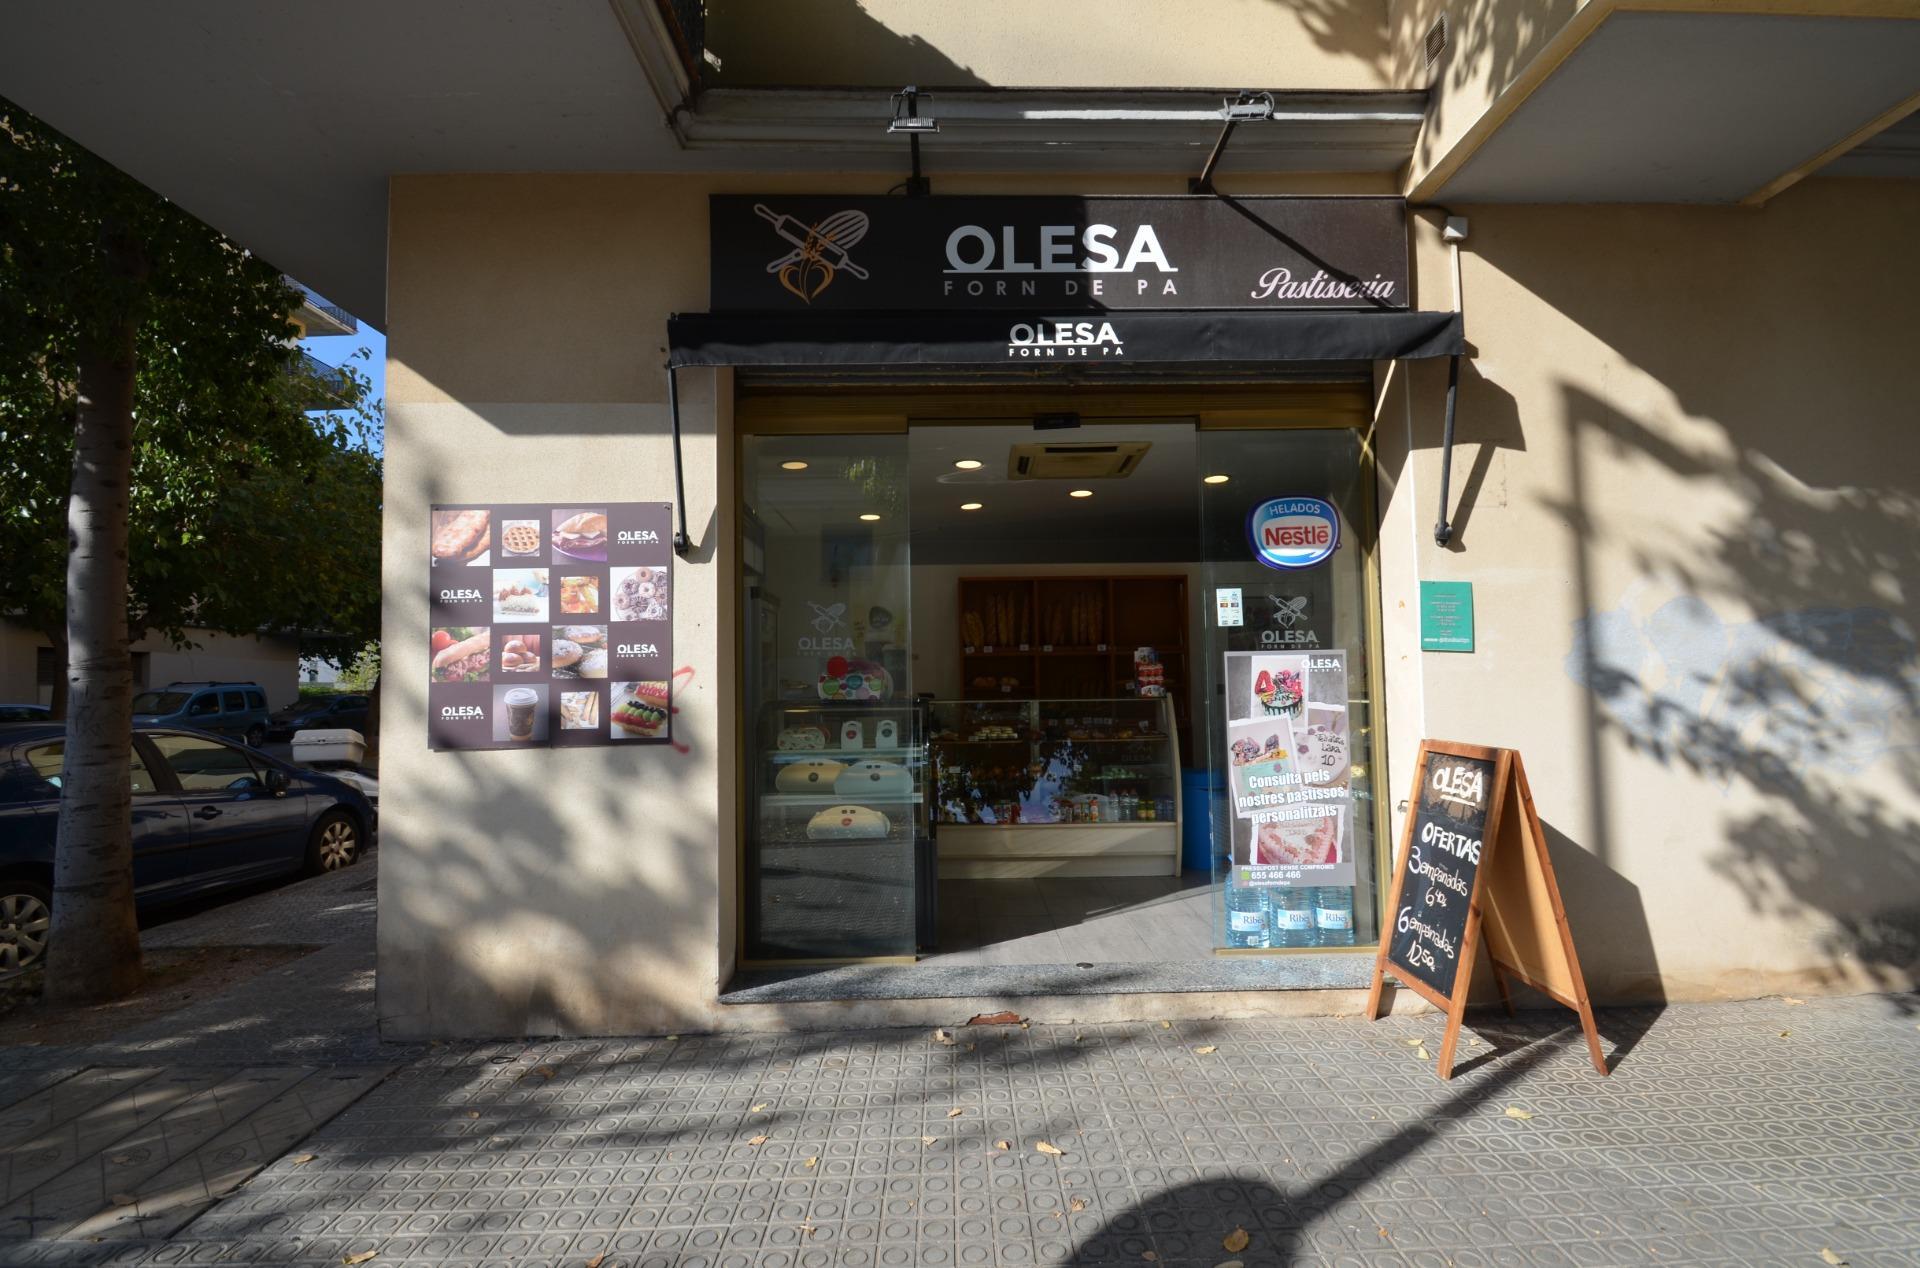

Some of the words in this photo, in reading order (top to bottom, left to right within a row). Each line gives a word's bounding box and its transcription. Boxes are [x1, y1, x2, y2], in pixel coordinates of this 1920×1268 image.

[945, 224, 1173, 273] OLESA
[944, 280, 1036, 295] FORN
[1065, 279, 1104, 295] DE
[1137, 278, 1178, 295] PA
[1250, 267, 1396, 299] Pastisseria
[1009, 322, 1122, 345] OLESA
[1009, 347, 1055, 357] FORN
[1067, 347, 1088, 356] DE
[1102, 346, 1124, 356] PA
[1269, 503, 1321, 516] HELADOS
[617, 530, 659, 540] OLESA
[440, 589, 482, 599] OLESA
[798, 637, 856, 650] OLESA
[1261, 630, 1318, 643] OLESA
[616, 644, 658, 654] OLESA
[1301, 658, 1341, 669] OLESA
[441, 706, 484, 716] OLESA
[1249, 772, 1301, 789] Consulta
[1304, 769, 1331, 784] pels
[1432, 766, 1483, 802] OLESA
[1239, 792, 1285, 808] nostres
[1287, 786, 1345, 804] pastissos
[1251, 805, 1337, 824] personalitzats
[1421, 821, 1482, 865] OFERTAS
[1268, 871, 1284, 879] 466
[1285, 871, 1301, 879] 466
[1408, 845, 1421, 874] 3
[1420, 862, 1468, 897] empanadas
[1398, 906, 1413, 933] 6
[1409, 917, 1455, 959] empanadas
